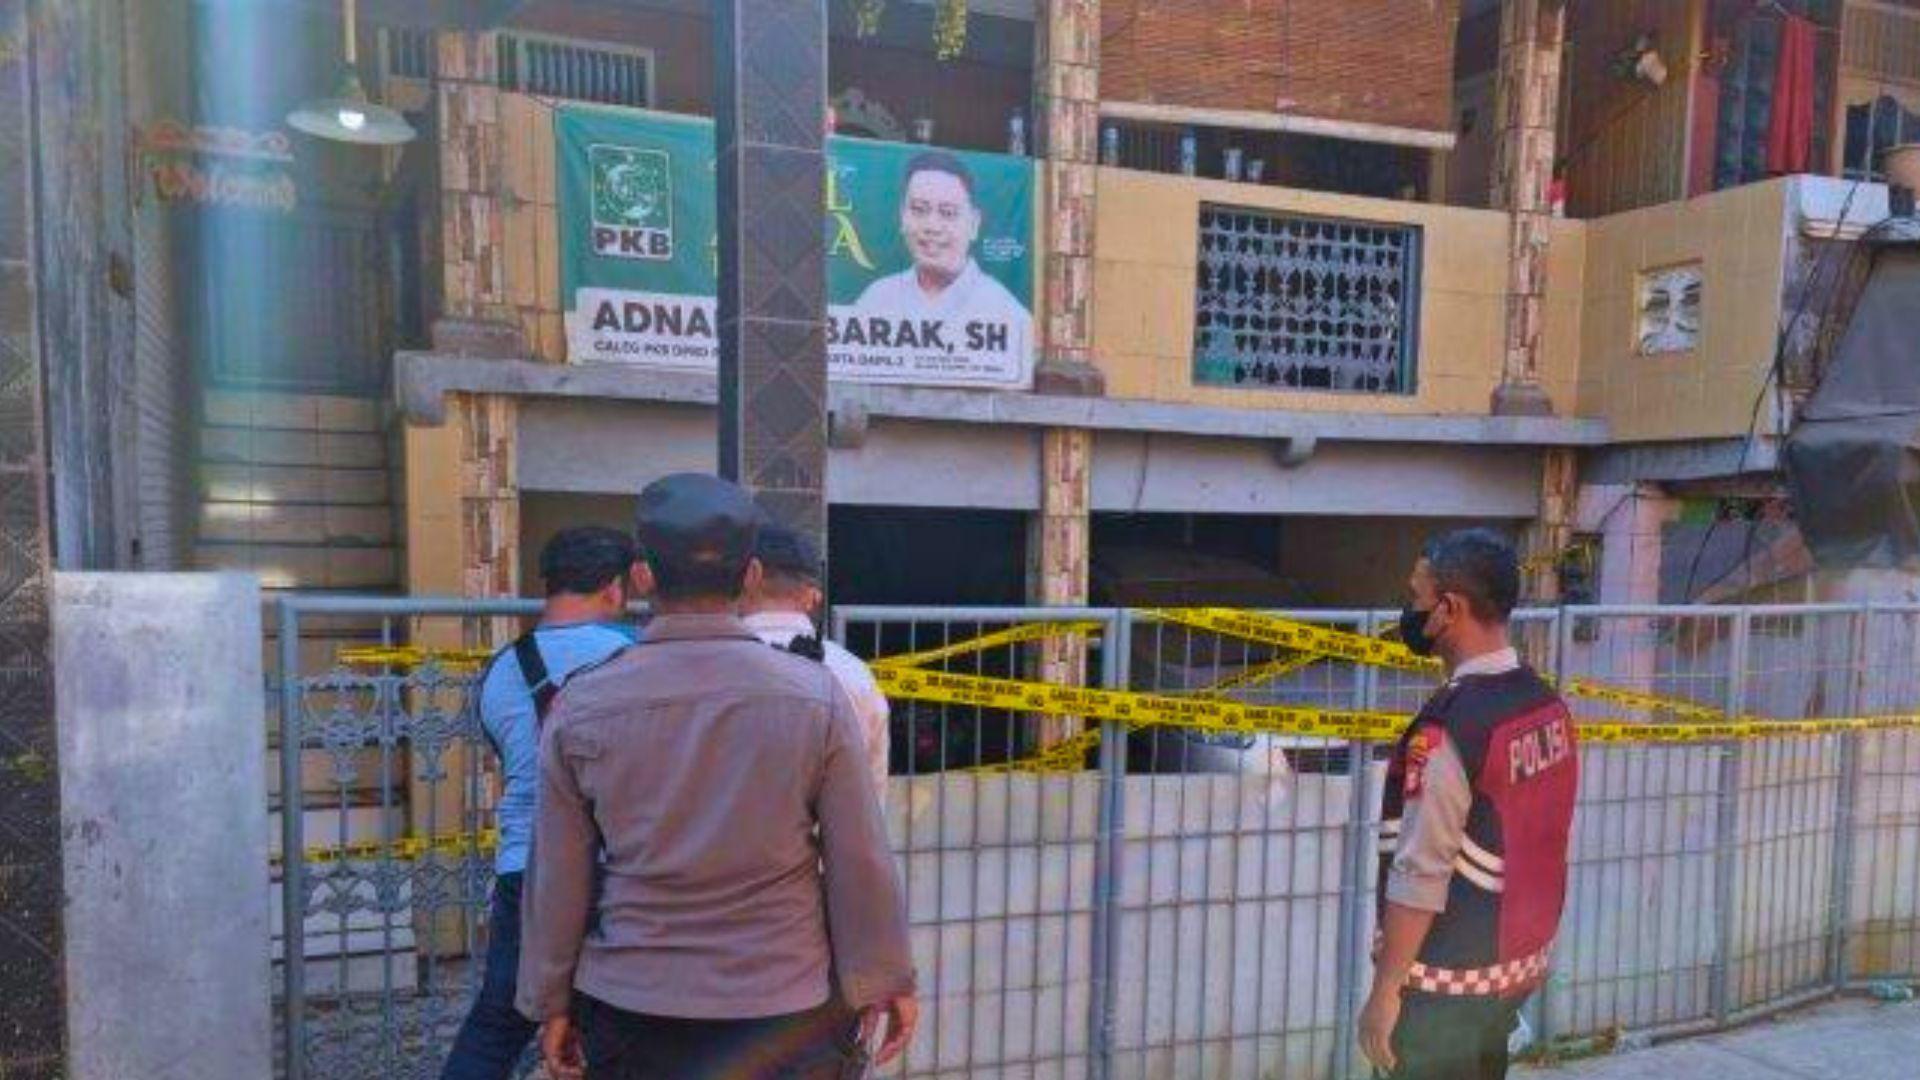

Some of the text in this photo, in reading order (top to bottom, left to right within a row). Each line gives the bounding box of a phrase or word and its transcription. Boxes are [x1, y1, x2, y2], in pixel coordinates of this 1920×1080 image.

[595, 227, 671, 256] PKB
[593, 299, 1008, 354] ADNA BARAK, SH
[1508, 717, 1569, 784] POLISI
